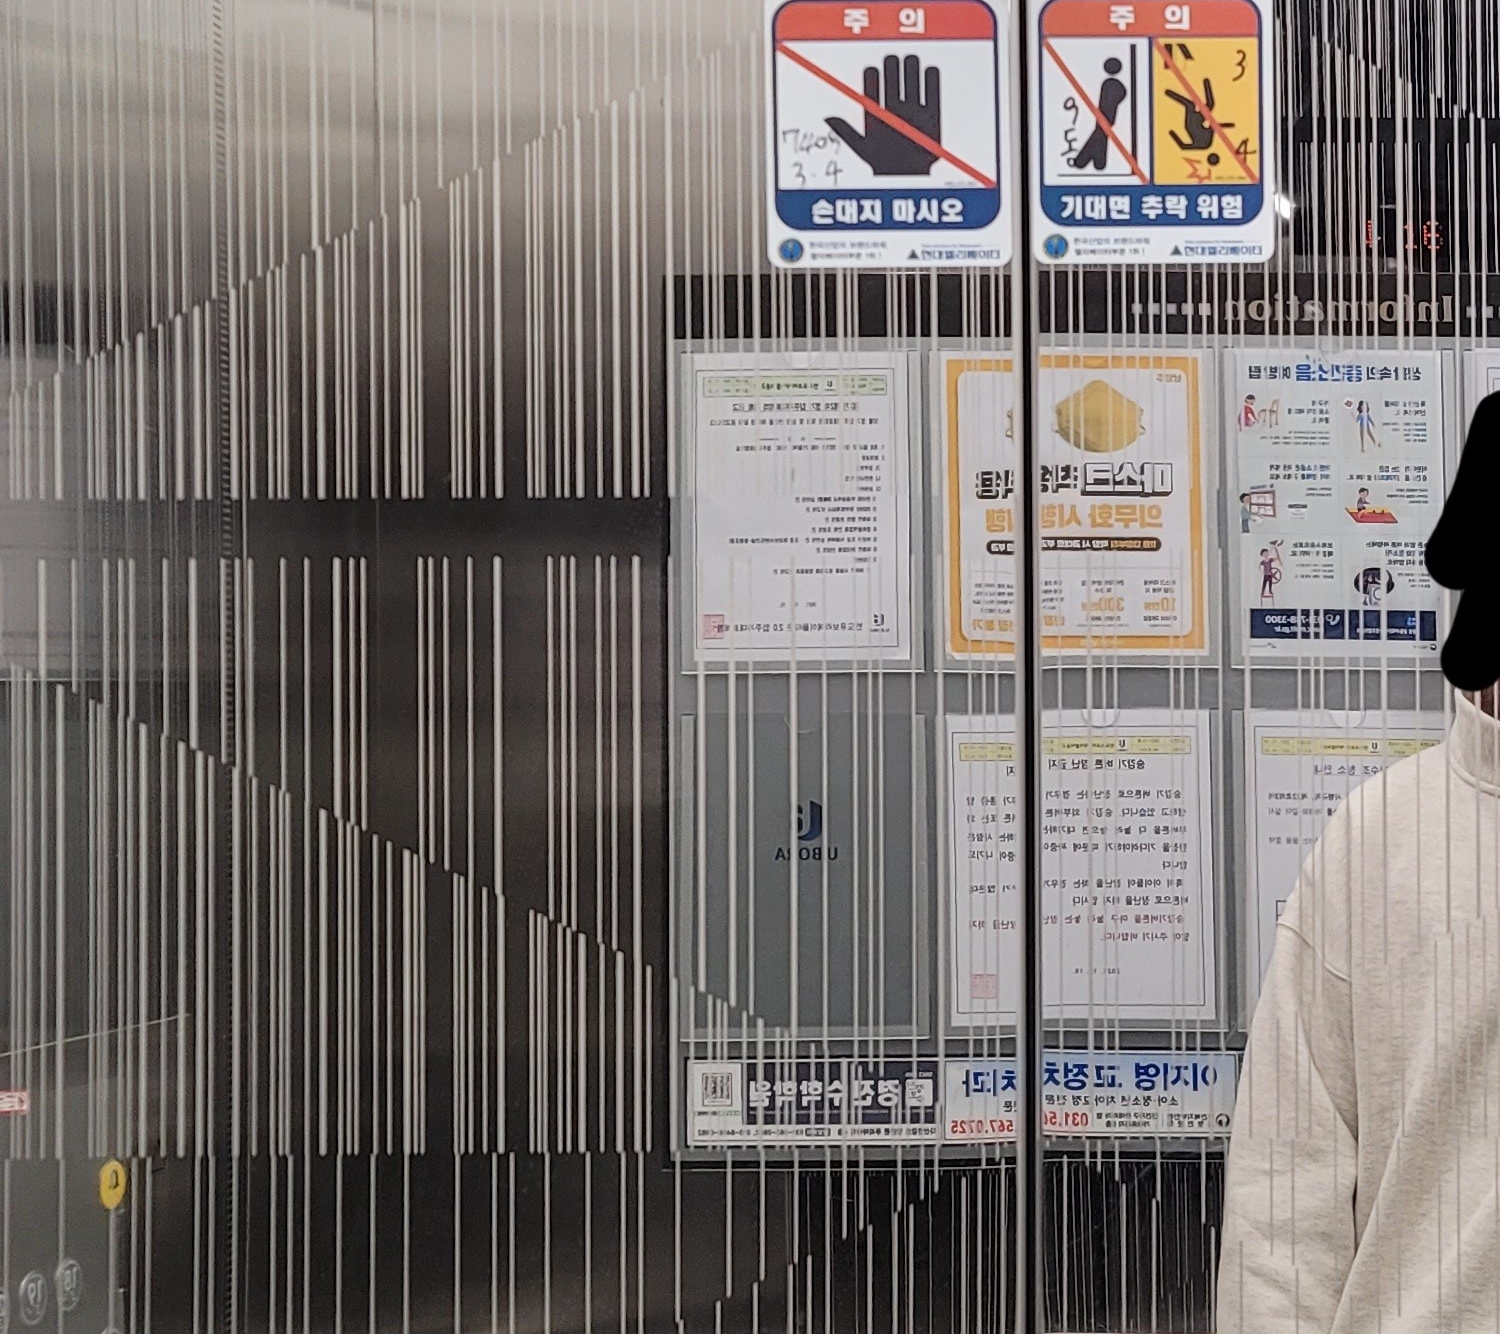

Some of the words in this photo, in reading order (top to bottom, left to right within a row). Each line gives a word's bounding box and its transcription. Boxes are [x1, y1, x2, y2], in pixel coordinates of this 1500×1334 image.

[810, 198, 883, 226] 손대지
[892, 197, 965, 224] 마시오
[1060, 194, 1131, 222] 기대면
[1141, 194, 1188, 221] 추락
[1195, 194, 1243, 220] 위험
